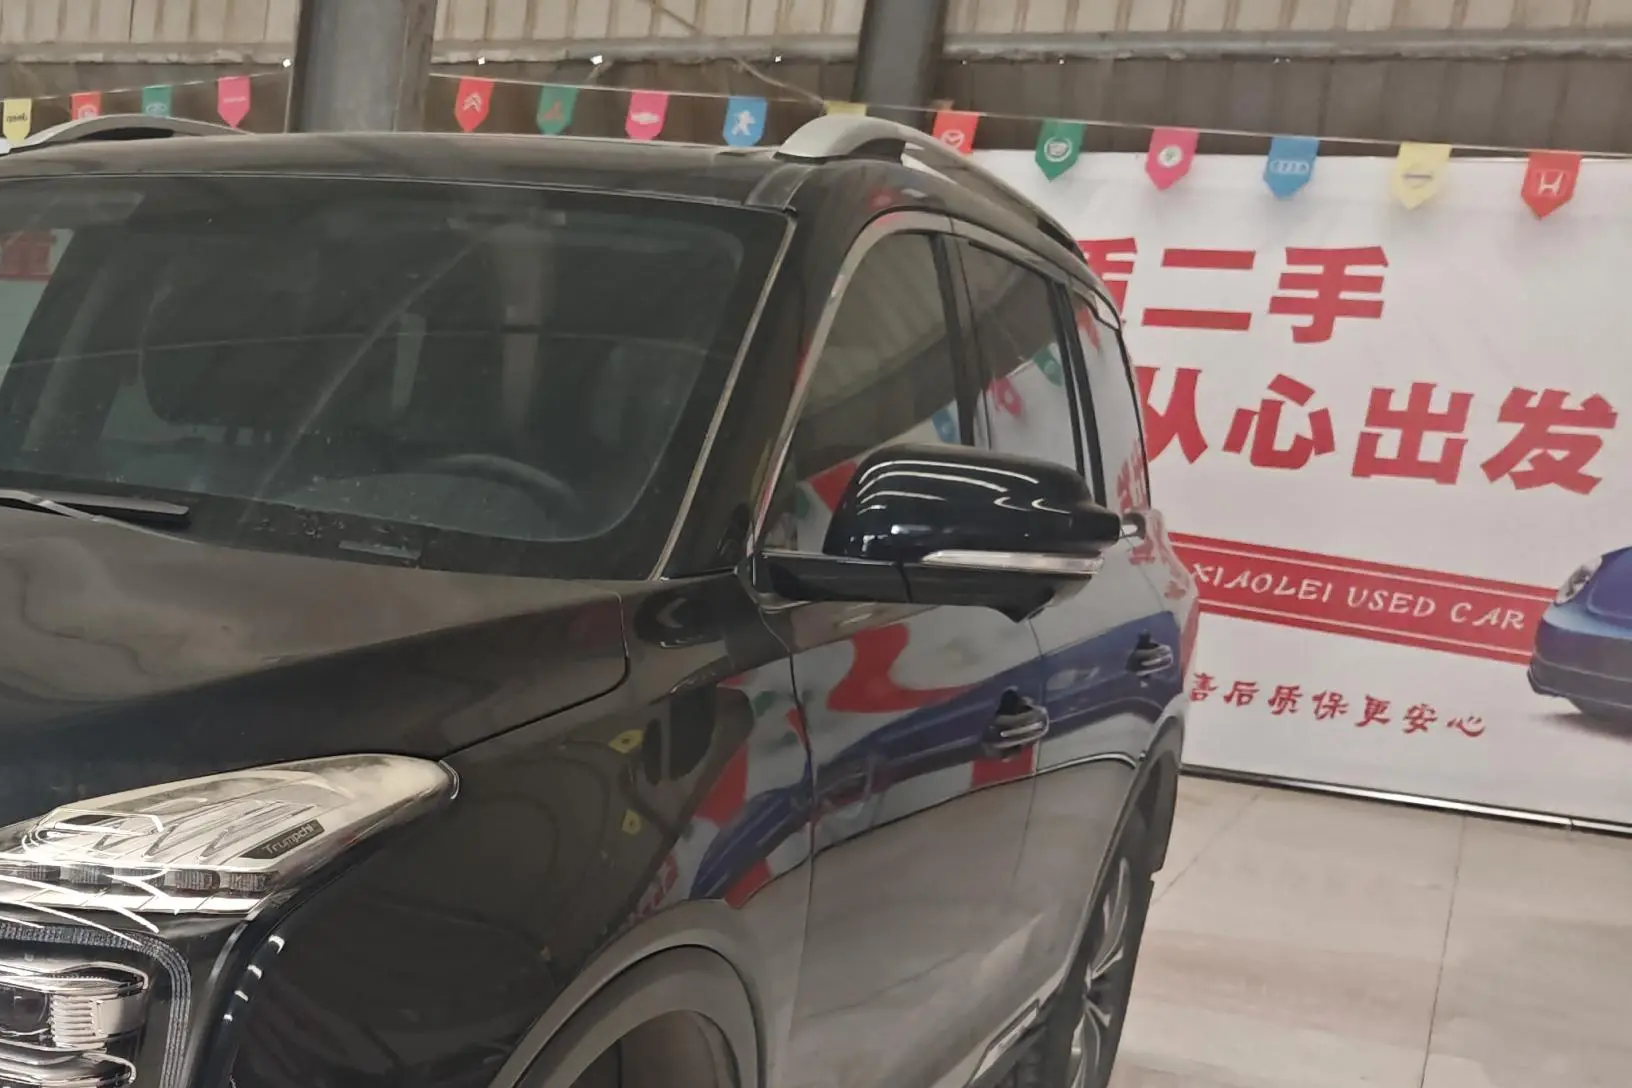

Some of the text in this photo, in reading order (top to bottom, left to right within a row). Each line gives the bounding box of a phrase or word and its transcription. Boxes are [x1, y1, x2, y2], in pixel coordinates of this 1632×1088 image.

[1191, 561, 1526, 631] XIAOLEI USED CAR
